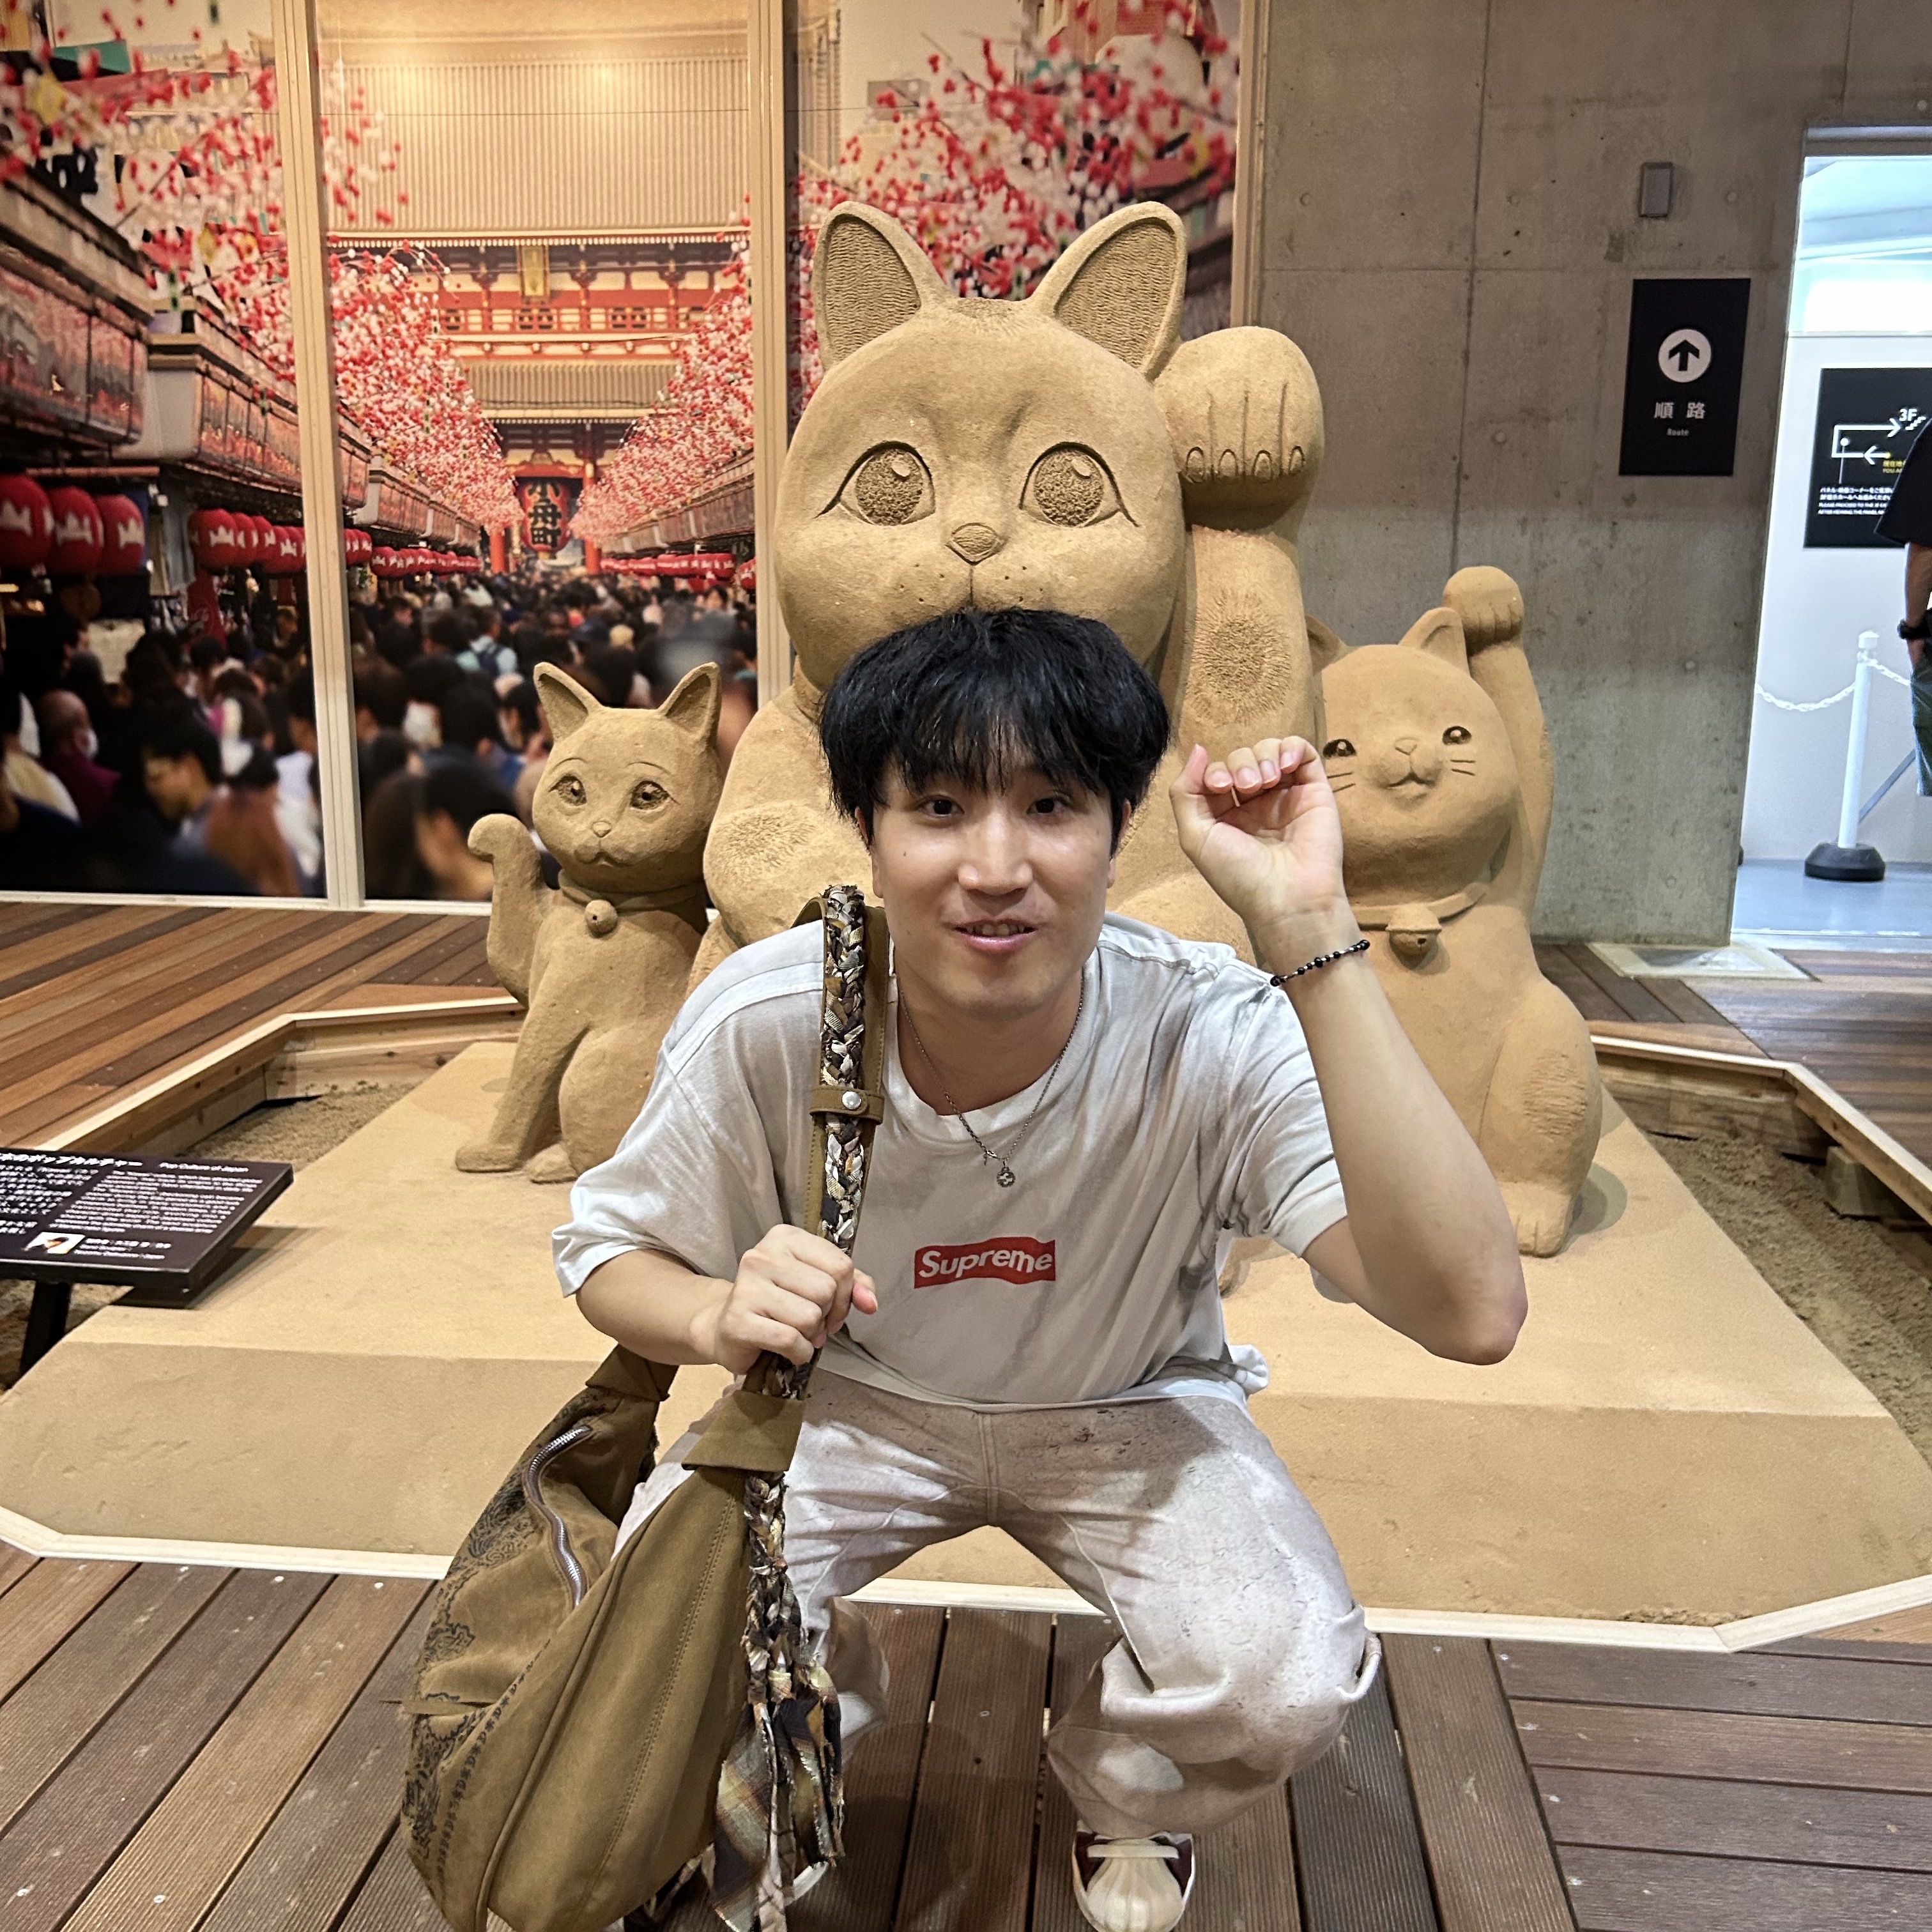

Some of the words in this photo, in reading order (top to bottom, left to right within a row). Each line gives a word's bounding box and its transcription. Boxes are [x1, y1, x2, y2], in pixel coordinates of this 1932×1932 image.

[1653, 401, 1705, 419] 順路
[1899, 408, 1917, 422] 3F
[919, 1249, 1053, 1278] Supreme
